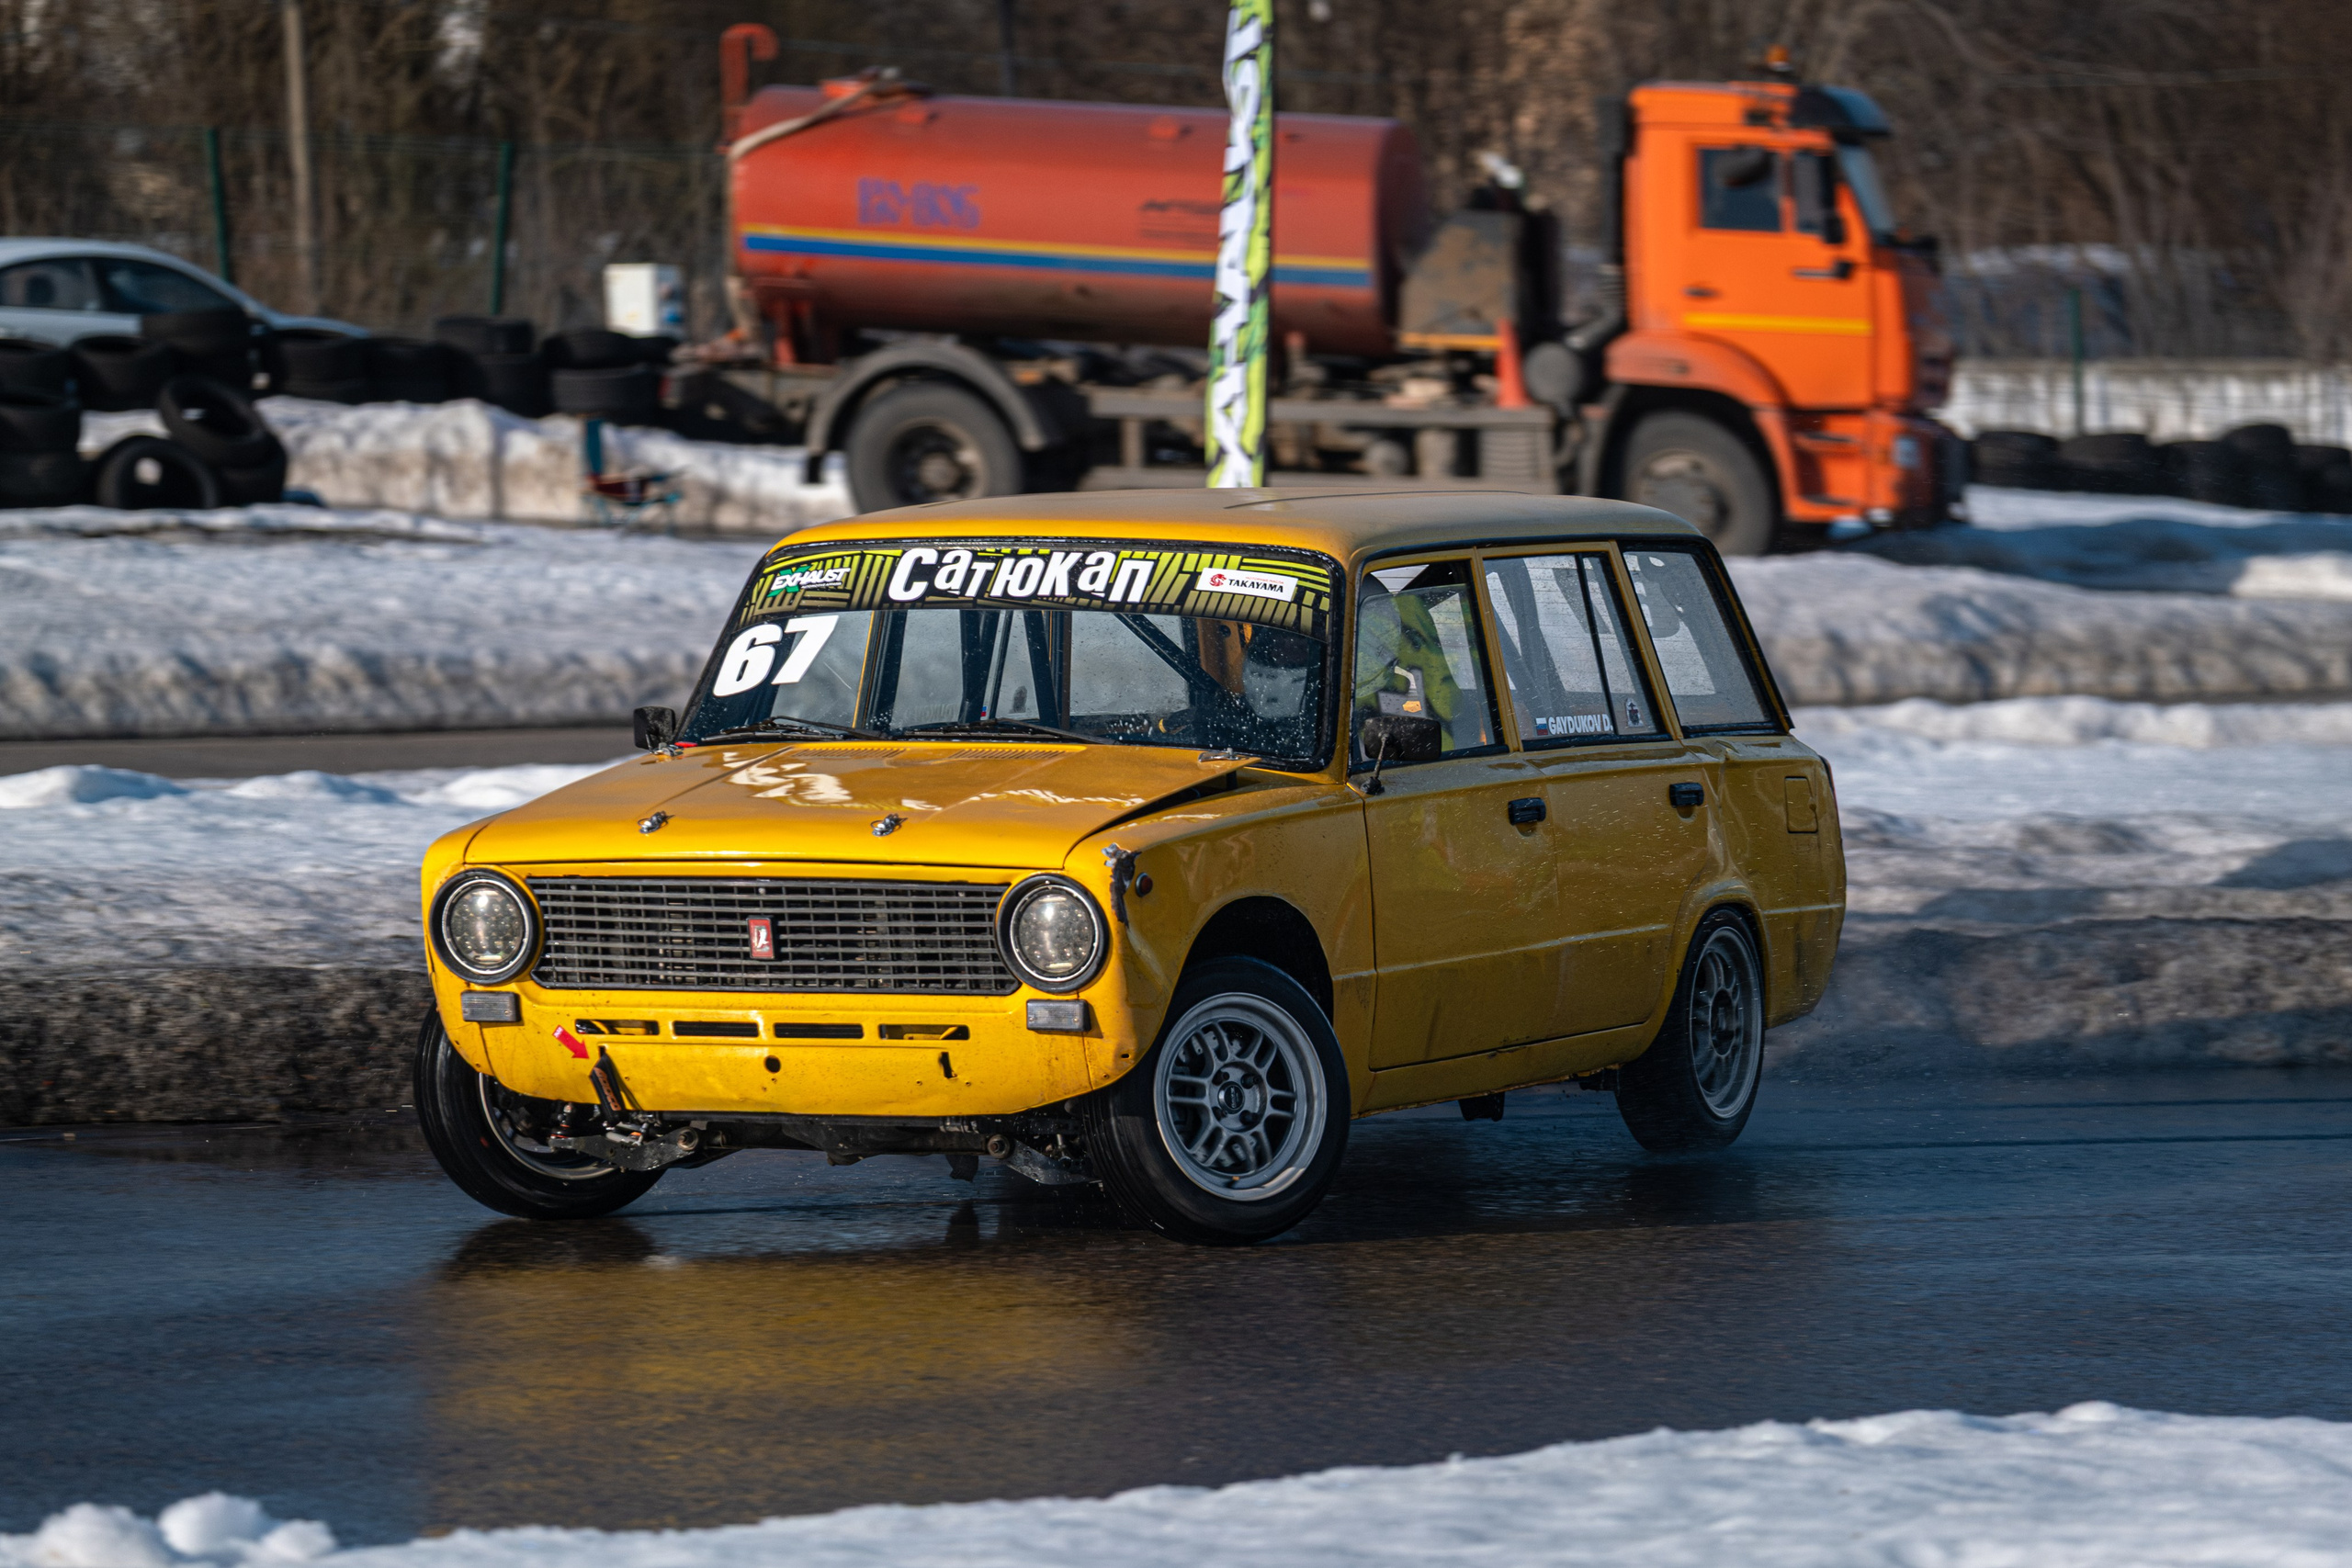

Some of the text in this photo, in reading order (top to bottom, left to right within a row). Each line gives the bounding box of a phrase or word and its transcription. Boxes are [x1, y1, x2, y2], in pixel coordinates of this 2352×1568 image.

[770, 568, 851, 591] EXHAUST
[1228, 579, 1283, 592] TAKAYAMA
[713, 615, 839, 697] 67
[1548, 715, 1601, 735] GAYDUKOV
